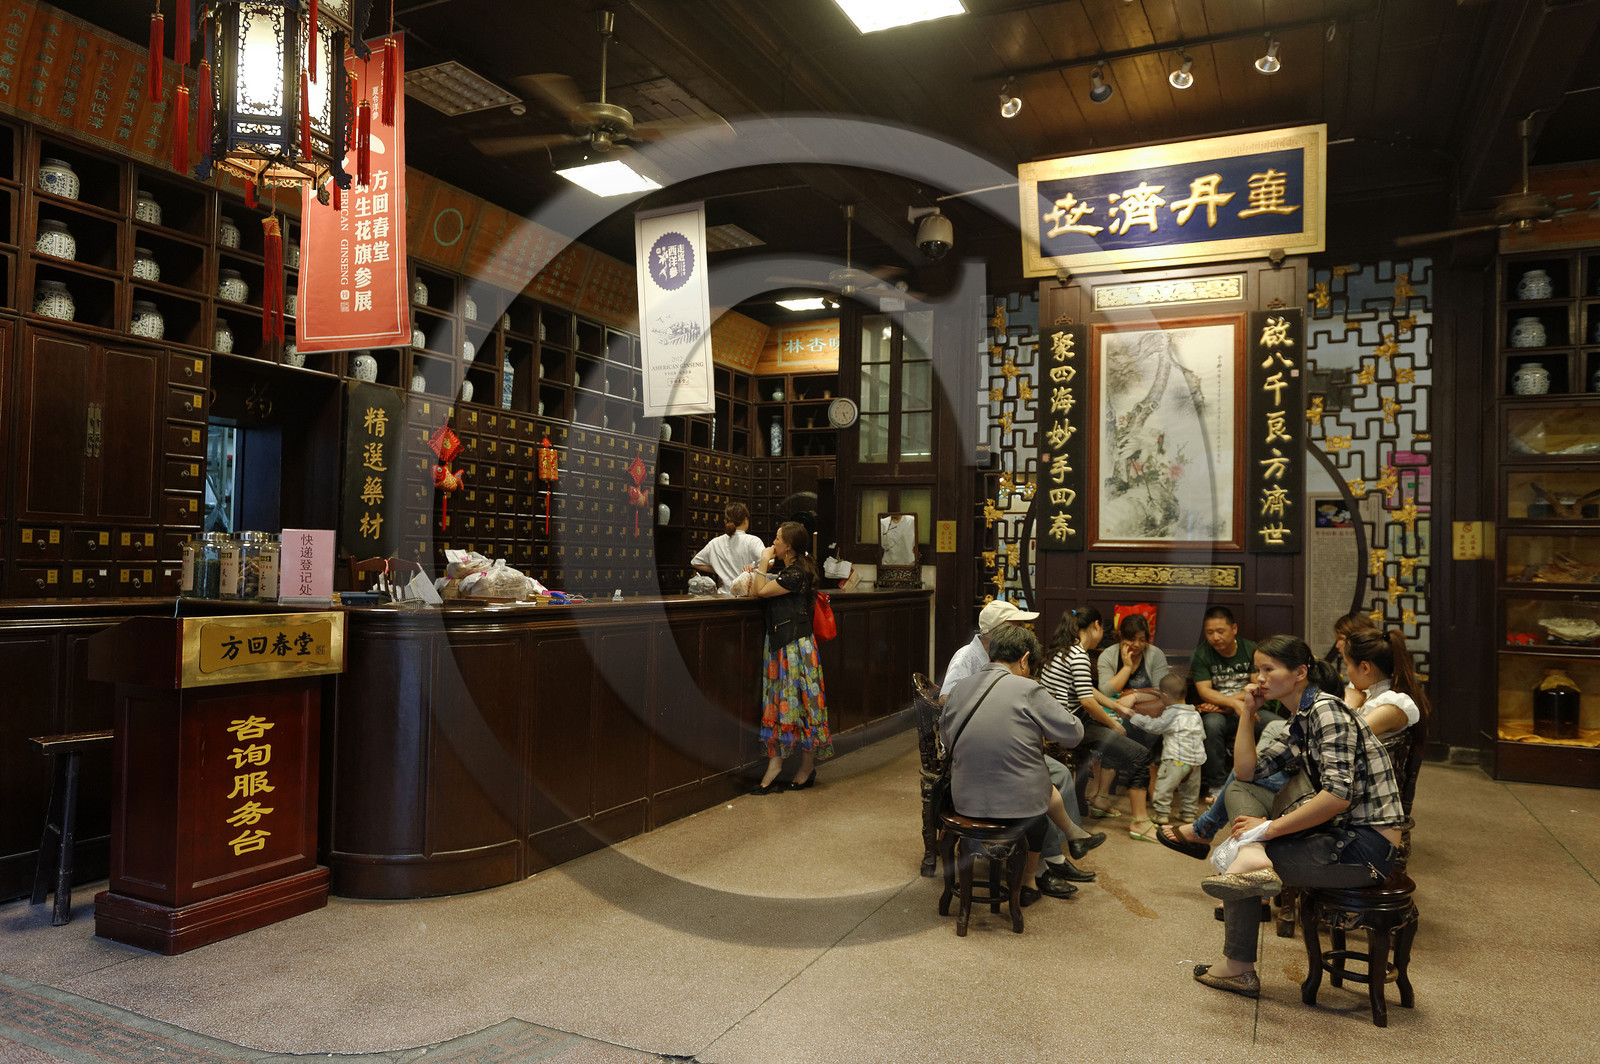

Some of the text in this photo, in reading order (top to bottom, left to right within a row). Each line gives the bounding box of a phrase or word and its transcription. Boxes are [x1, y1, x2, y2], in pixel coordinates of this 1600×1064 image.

[341, 189, 349, 231] ERICAN
[372, 170, 390, 262] 方回春堂
[341, 238, 350, 286] GINSENG
[652, 357, 704, 372] AMERICAN GINSENG
[359, 406, 388, 540] 精選藥材
[300, 533, 314, 596] 快递登记处
[220, 630, 315, 661] 方回春堂
[226, 715, 275, 857] 咨询服务台
